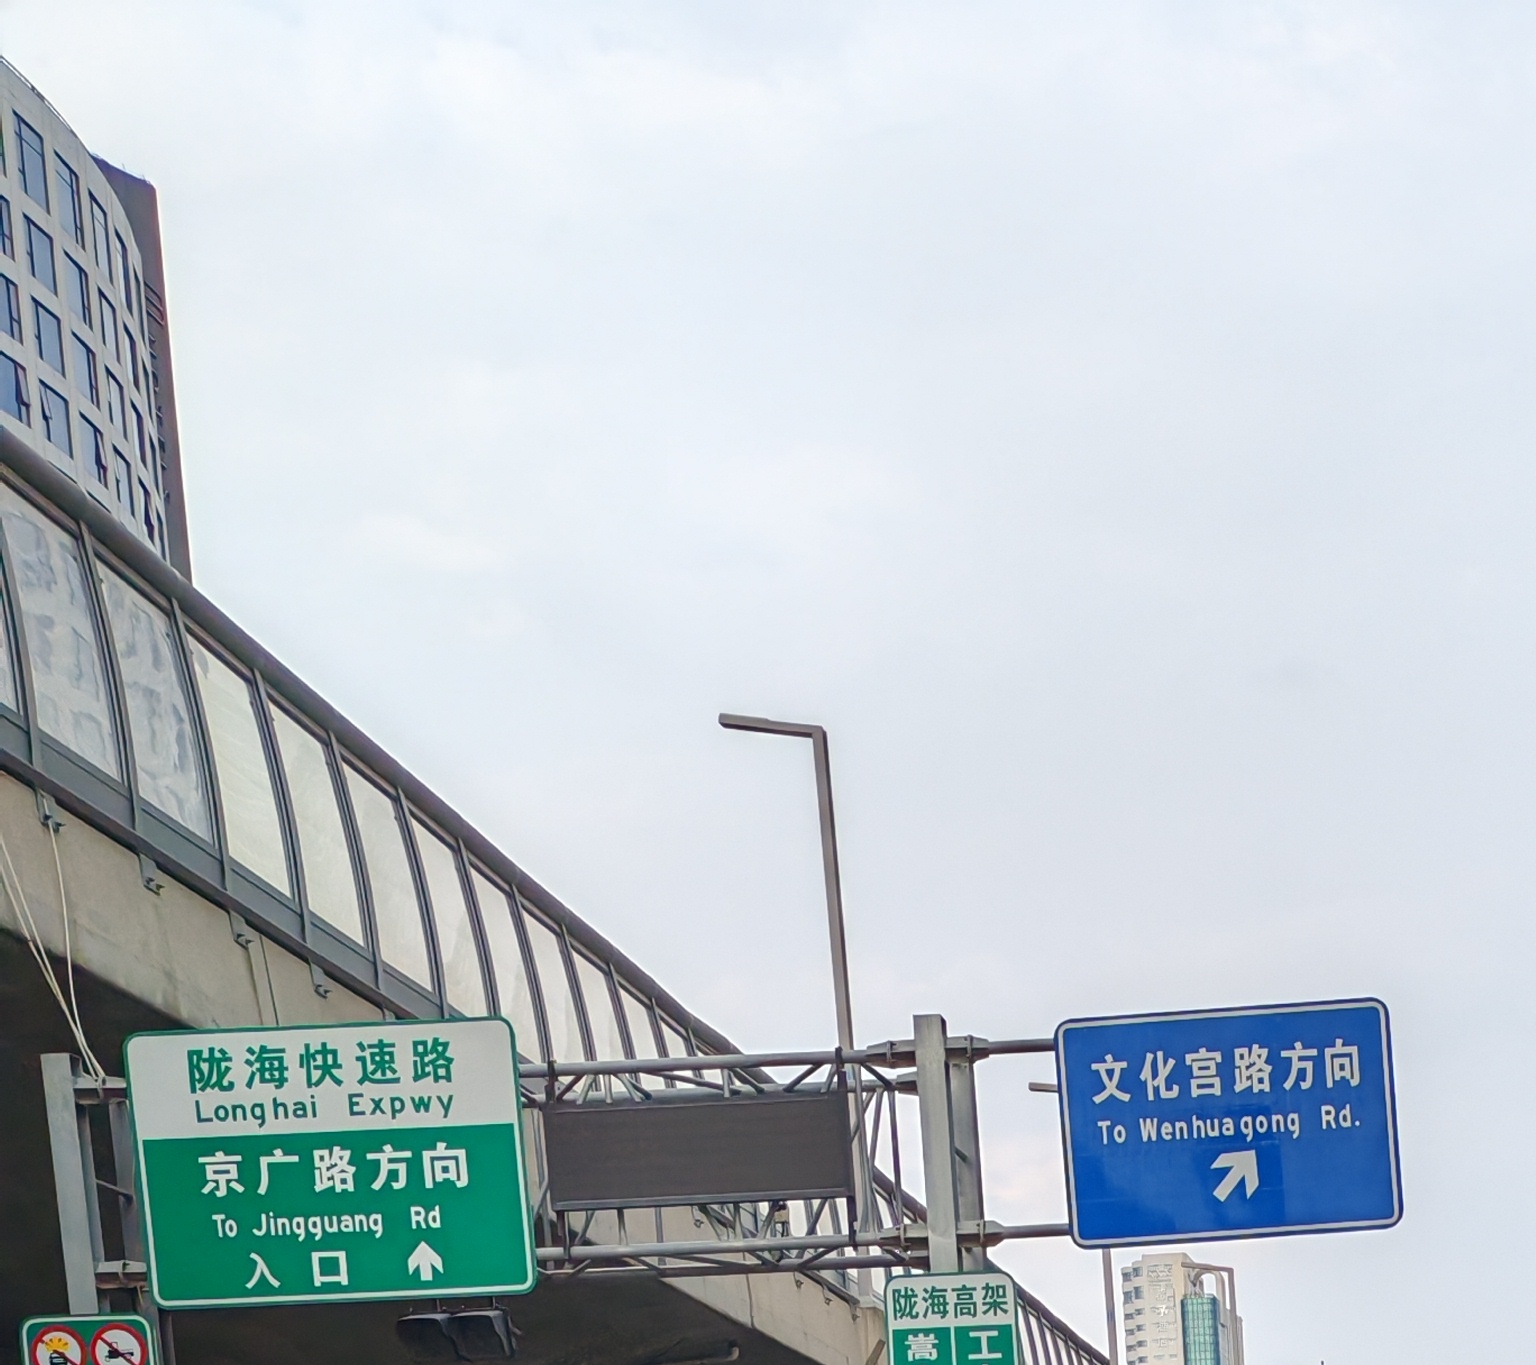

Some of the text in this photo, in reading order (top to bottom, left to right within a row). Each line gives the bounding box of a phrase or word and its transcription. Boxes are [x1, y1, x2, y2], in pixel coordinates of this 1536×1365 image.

[187, 1038, 454, 1093] 陇海快速路
[1091, 1039, 1361, 1104] 文化宫路方向
[195, 1091, 453, 1127] Longhai Expwy
[1098, 1104, 1361, 1144] To Wenhuagong Rd.
[198, 1141, 469, 1196] 京广路方向
[213, 1206, 440, 1240] To Jingguang Rd
[245, 1251, 349, 1287] 入口
[892, 1282, 1009, 1321] 陇海高架
